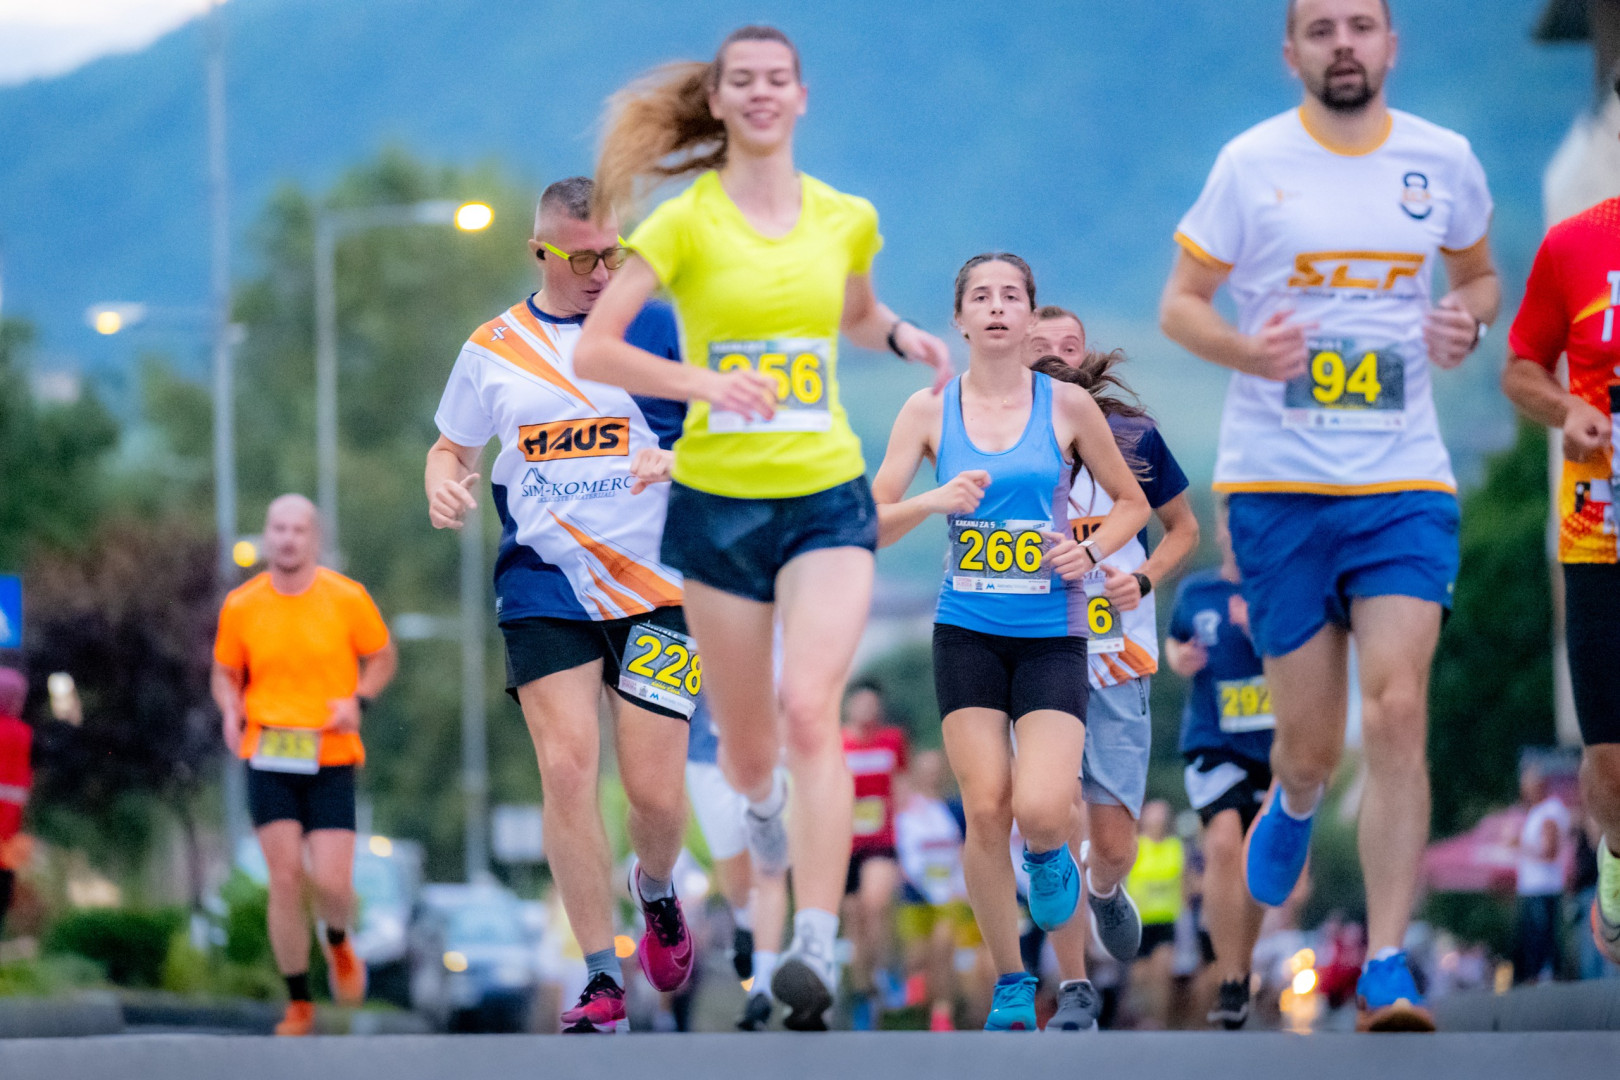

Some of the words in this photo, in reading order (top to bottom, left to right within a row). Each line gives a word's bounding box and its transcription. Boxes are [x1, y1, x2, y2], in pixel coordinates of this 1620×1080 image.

[1311, 351, 1382, 403] 94
[523, 423, 625, 455] HAUS
[521, 475, 636, 497] SIM-KOMERC
[959, 529, 1043, 573] 266
[627, 635, 702, 697] 228
